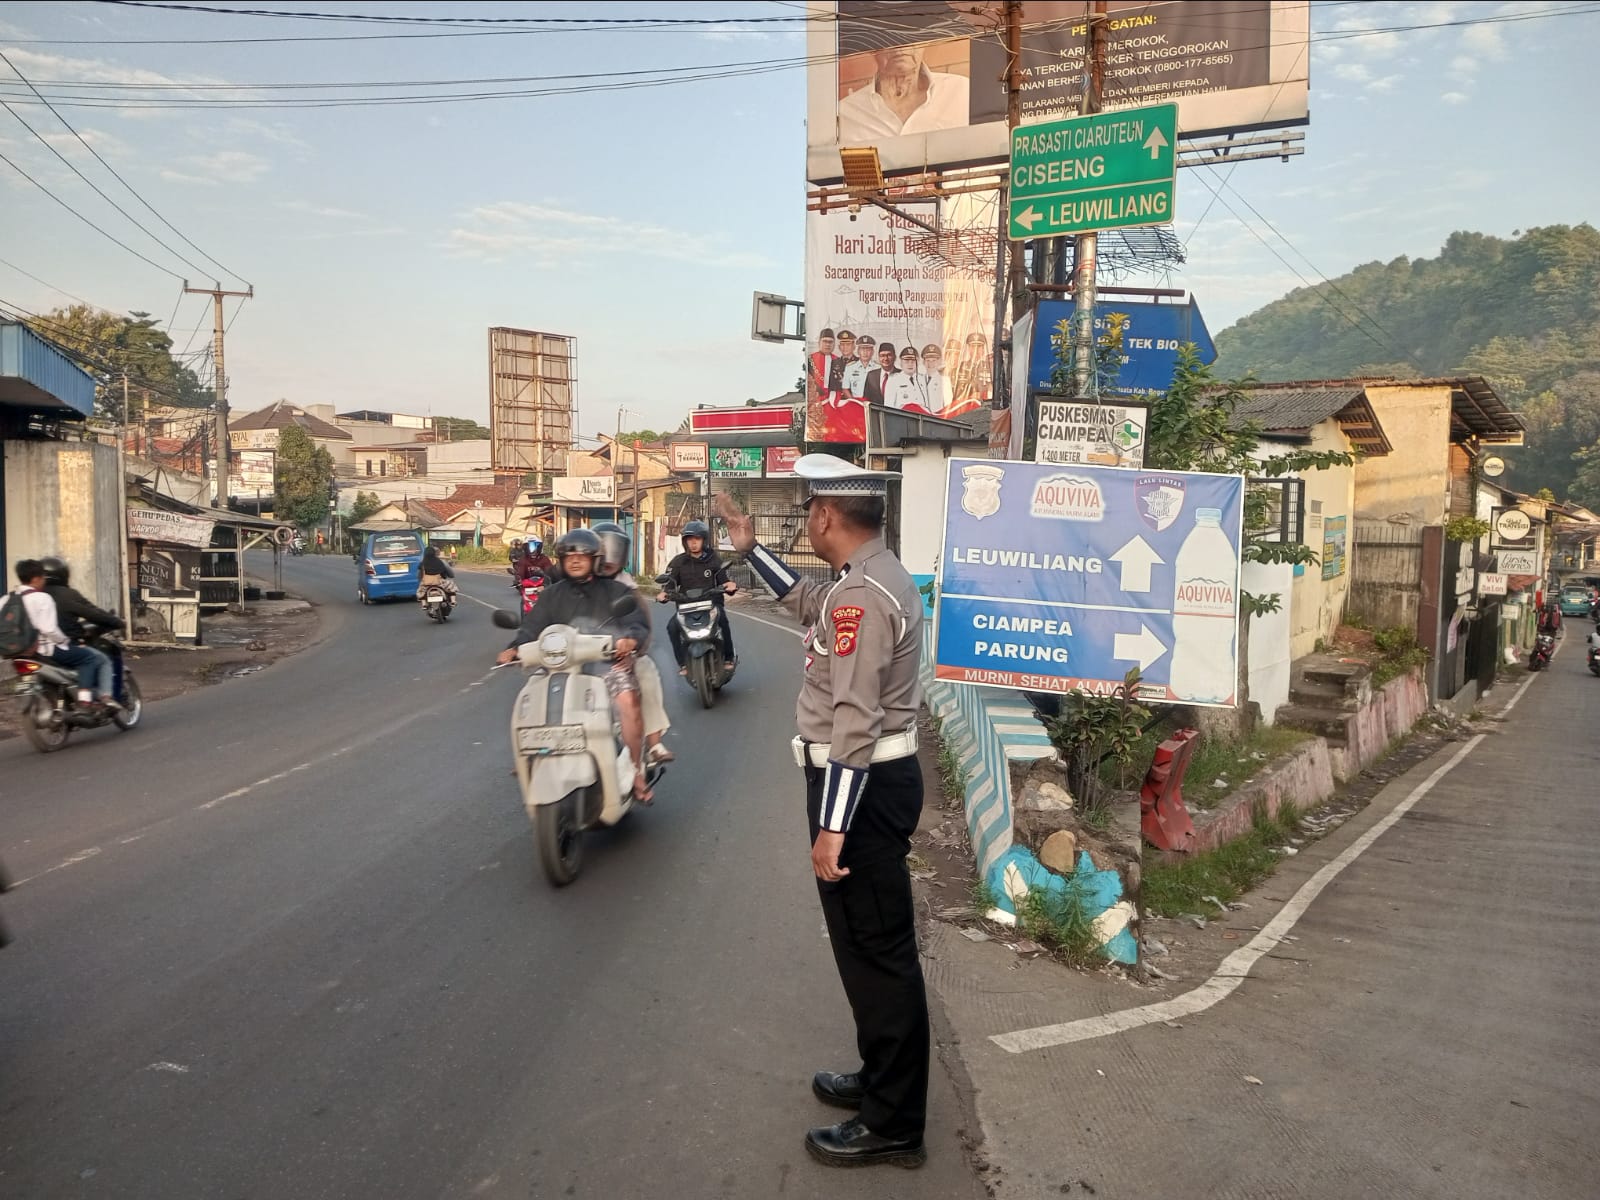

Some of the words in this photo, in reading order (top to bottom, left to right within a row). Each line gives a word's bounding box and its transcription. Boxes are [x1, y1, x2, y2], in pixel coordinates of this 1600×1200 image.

[1072, 17, 1156, 36] PEGATAN:
[1108, 35, 1169, 50] MEROKOK,
[1035, 61, 1085, 75] TERKENA
[1138, 40, 1228, 60] TENGGOROKAN
[1154, 55, 1233, 75] (0800-177-6565)
[1023, 97, 1065, 110] DILARANG
[1108, 89, 1127, 98] DAN
[1130, 83, 1171, 94] MEMBERI
[1173, 79, 1209, 89] KEPADA
[1142, 90, 1200, 102] PEREMPUAN
[1014, 131, 1072, 157] PRASASTI
[1075, 120, 1143, 150] CIARUTEUN
[1014, 156, 1104, 187] CISEENG
[1050, 192, 1167, 225] LEUWILIANG
[886, 208, 941, 230] Selama
[835, 235, 864, 255] Hari
[869, 235, 896, 255] Jadi
[825, 265, 882, 282] Sacangreud
[886, 265, 920, 282] Pageuh
[925, 307, 945, 320] Bogo
[1129, 338, 1151, 350] TEK
[1156, 339, 1178, 351] BIO
[1040, 405, 1115, 425] PUSKESMAS
[1038, 424, 1107, 443] CIAMPEA
[1059, 451, 1080, 463] METER
[1034, 485, 1100, 508] AQUVIVA
[952, 547, 1102, 574] LEUWILIANG
[1177, 584, 1233, 603] AQUVIVA
[972, 614, 1073, 637] CIAMPEA
[974, 641, 1068, 663] PARUNG
